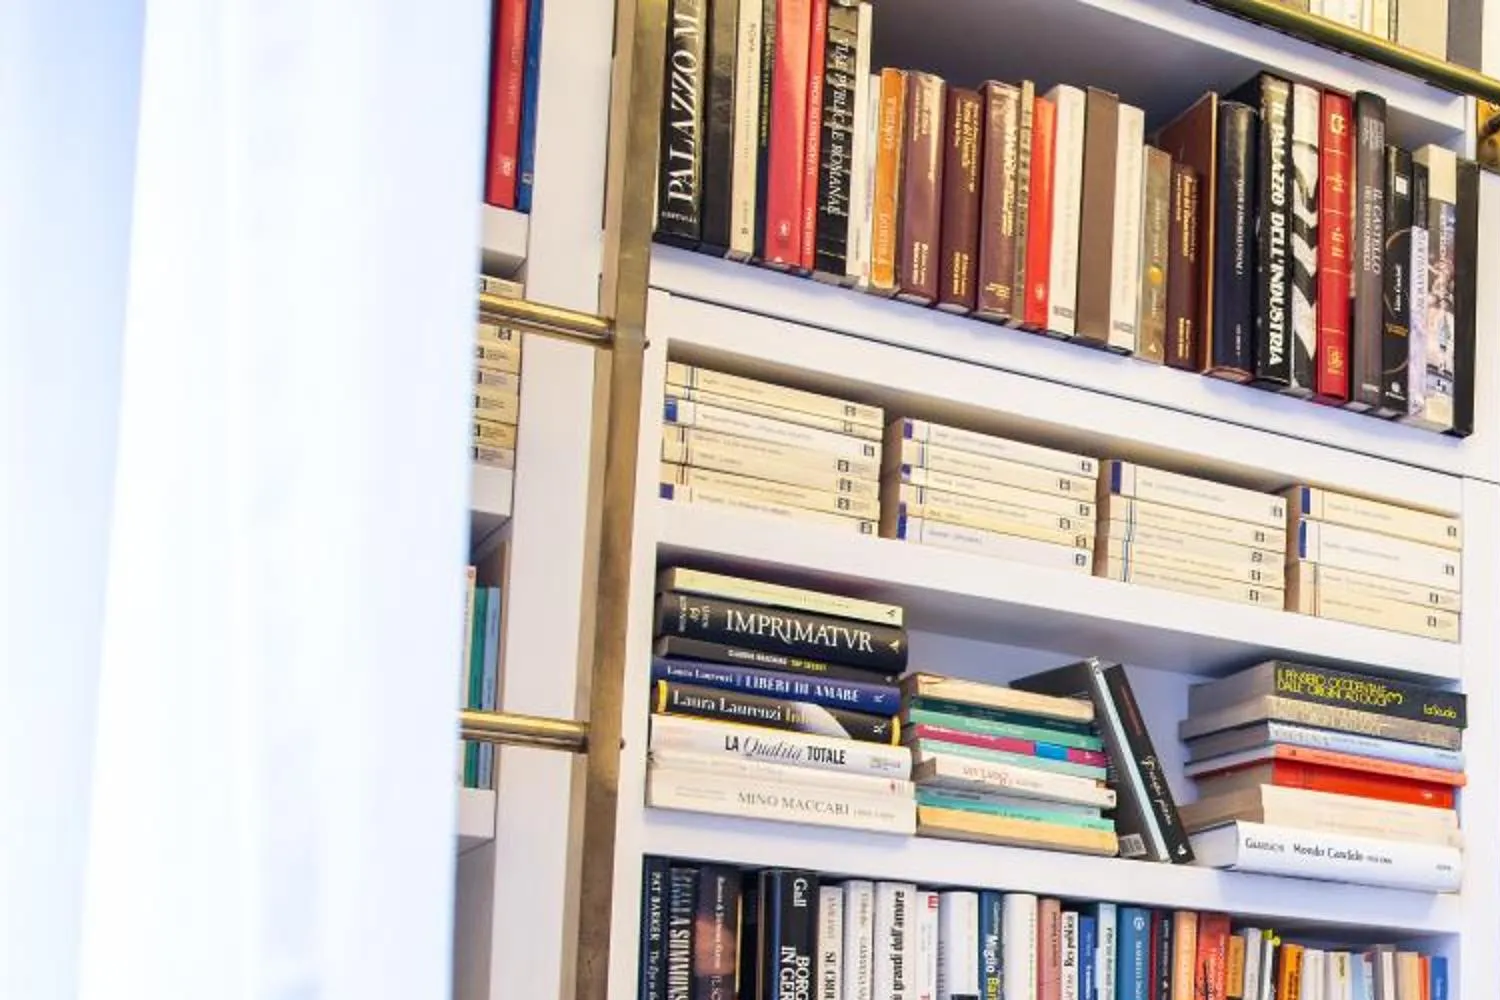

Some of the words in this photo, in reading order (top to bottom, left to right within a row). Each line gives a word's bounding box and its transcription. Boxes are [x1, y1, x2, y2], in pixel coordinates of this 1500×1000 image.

[667, 50, 697, 204] PALAZZO
[826, 143, 845, 216] ROMANAE
[1270, 124, 1284, 205] PALAZZO
[1372, 206, 1381, 275] CASTELLO
[1269, 212, 1284, 365] DELL'INDUSTRIA
[726, 609, 873, 652] IMPRIMATVR
[673, 690, 715, 711] Laura
[720, 697, 781, 721] Laurenzi
[745, 675, 790, 693] LIBERI
[794, 682, 809, 695] DI
[814, 684, 860, 702] AMARE
[725, 735, 739, 751] LA
[807, 745, 845, 765] TOTALE
[737, 792, 778, 808] MINO
[782, 796, 849, 816] MACCARI
[793, 878, 807, 907] Gall
[781, 946, 795, 963] IN
[891, 955, 904, 991] grandi
